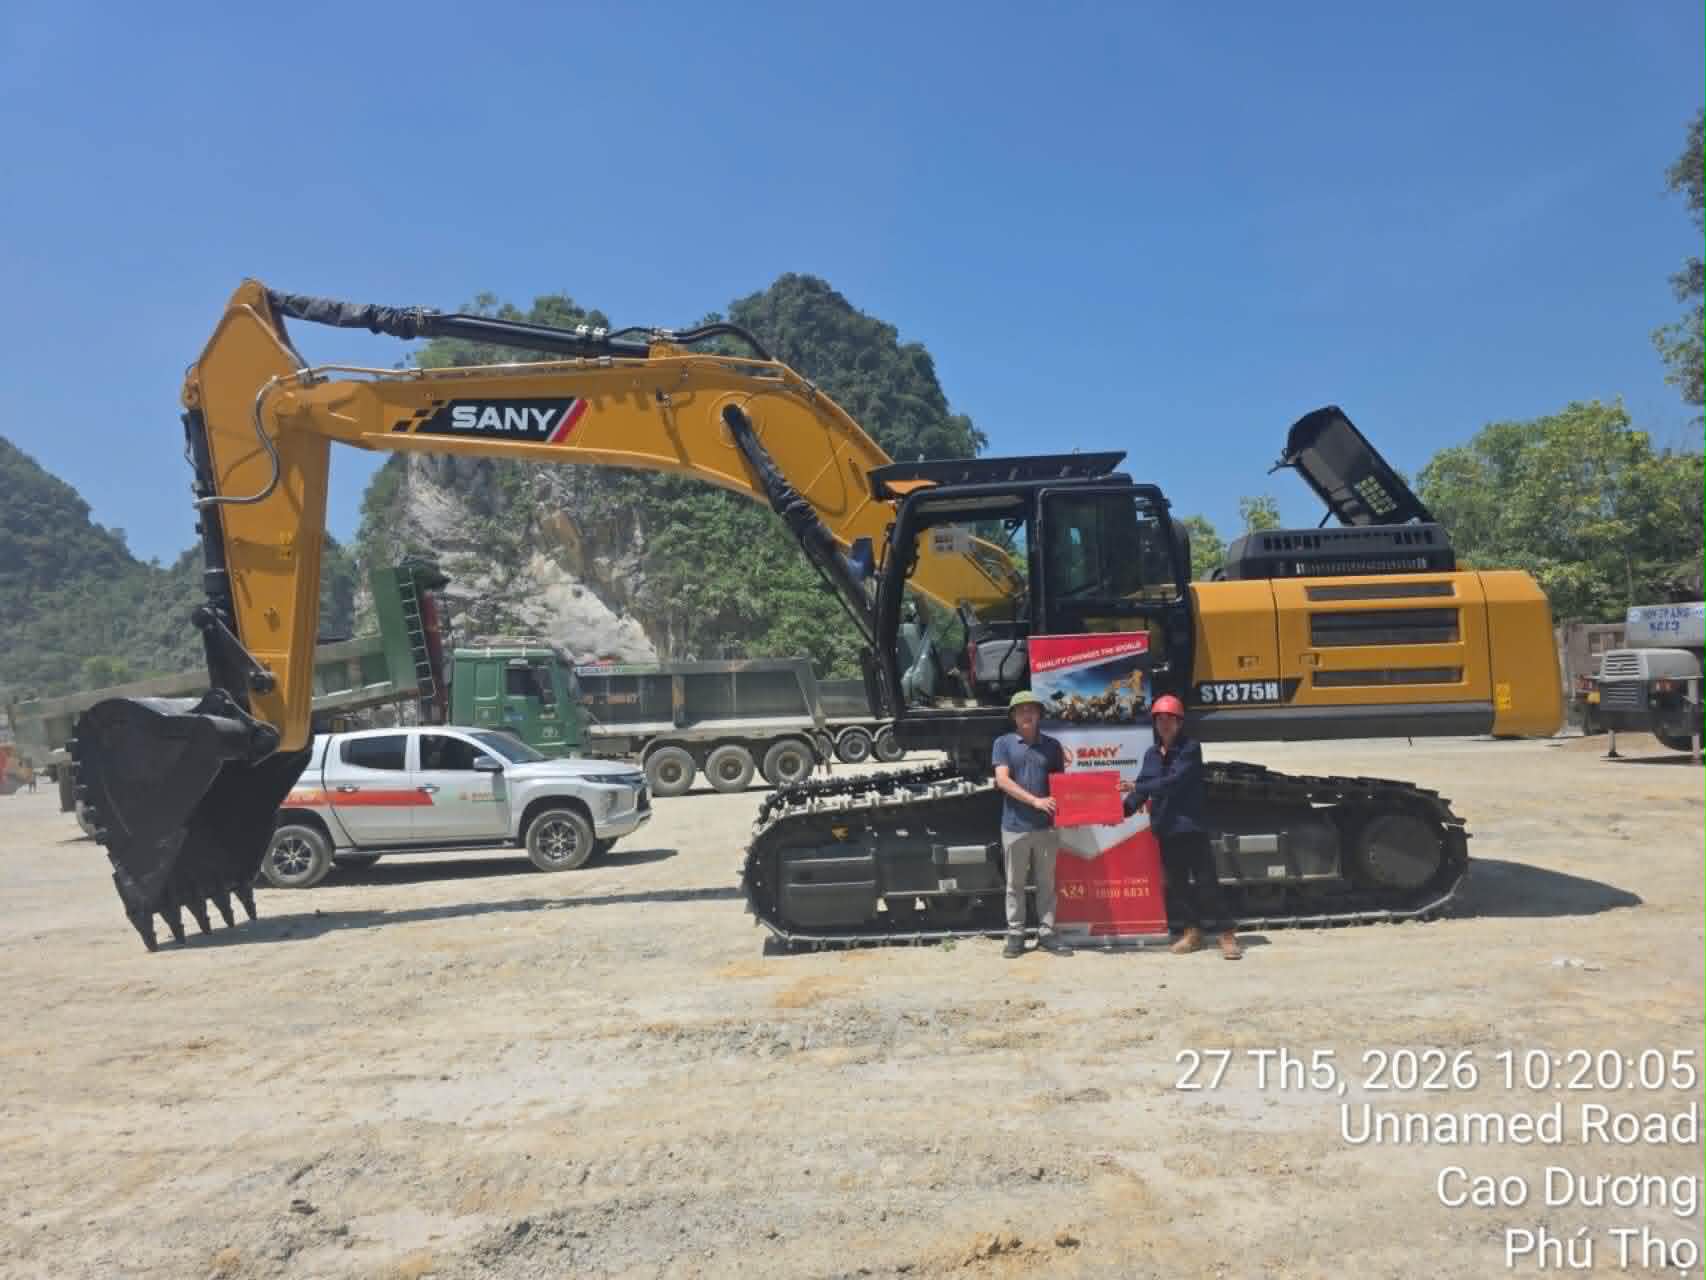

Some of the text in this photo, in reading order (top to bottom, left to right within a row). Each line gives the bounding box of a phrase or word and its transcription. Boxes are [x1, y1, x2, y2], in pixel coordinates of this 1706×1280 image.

[452, 406, 556, 431] SANY
[1201, 682, 1279, 702] SY375H
[1077, 747, 1118, 758] SANY
